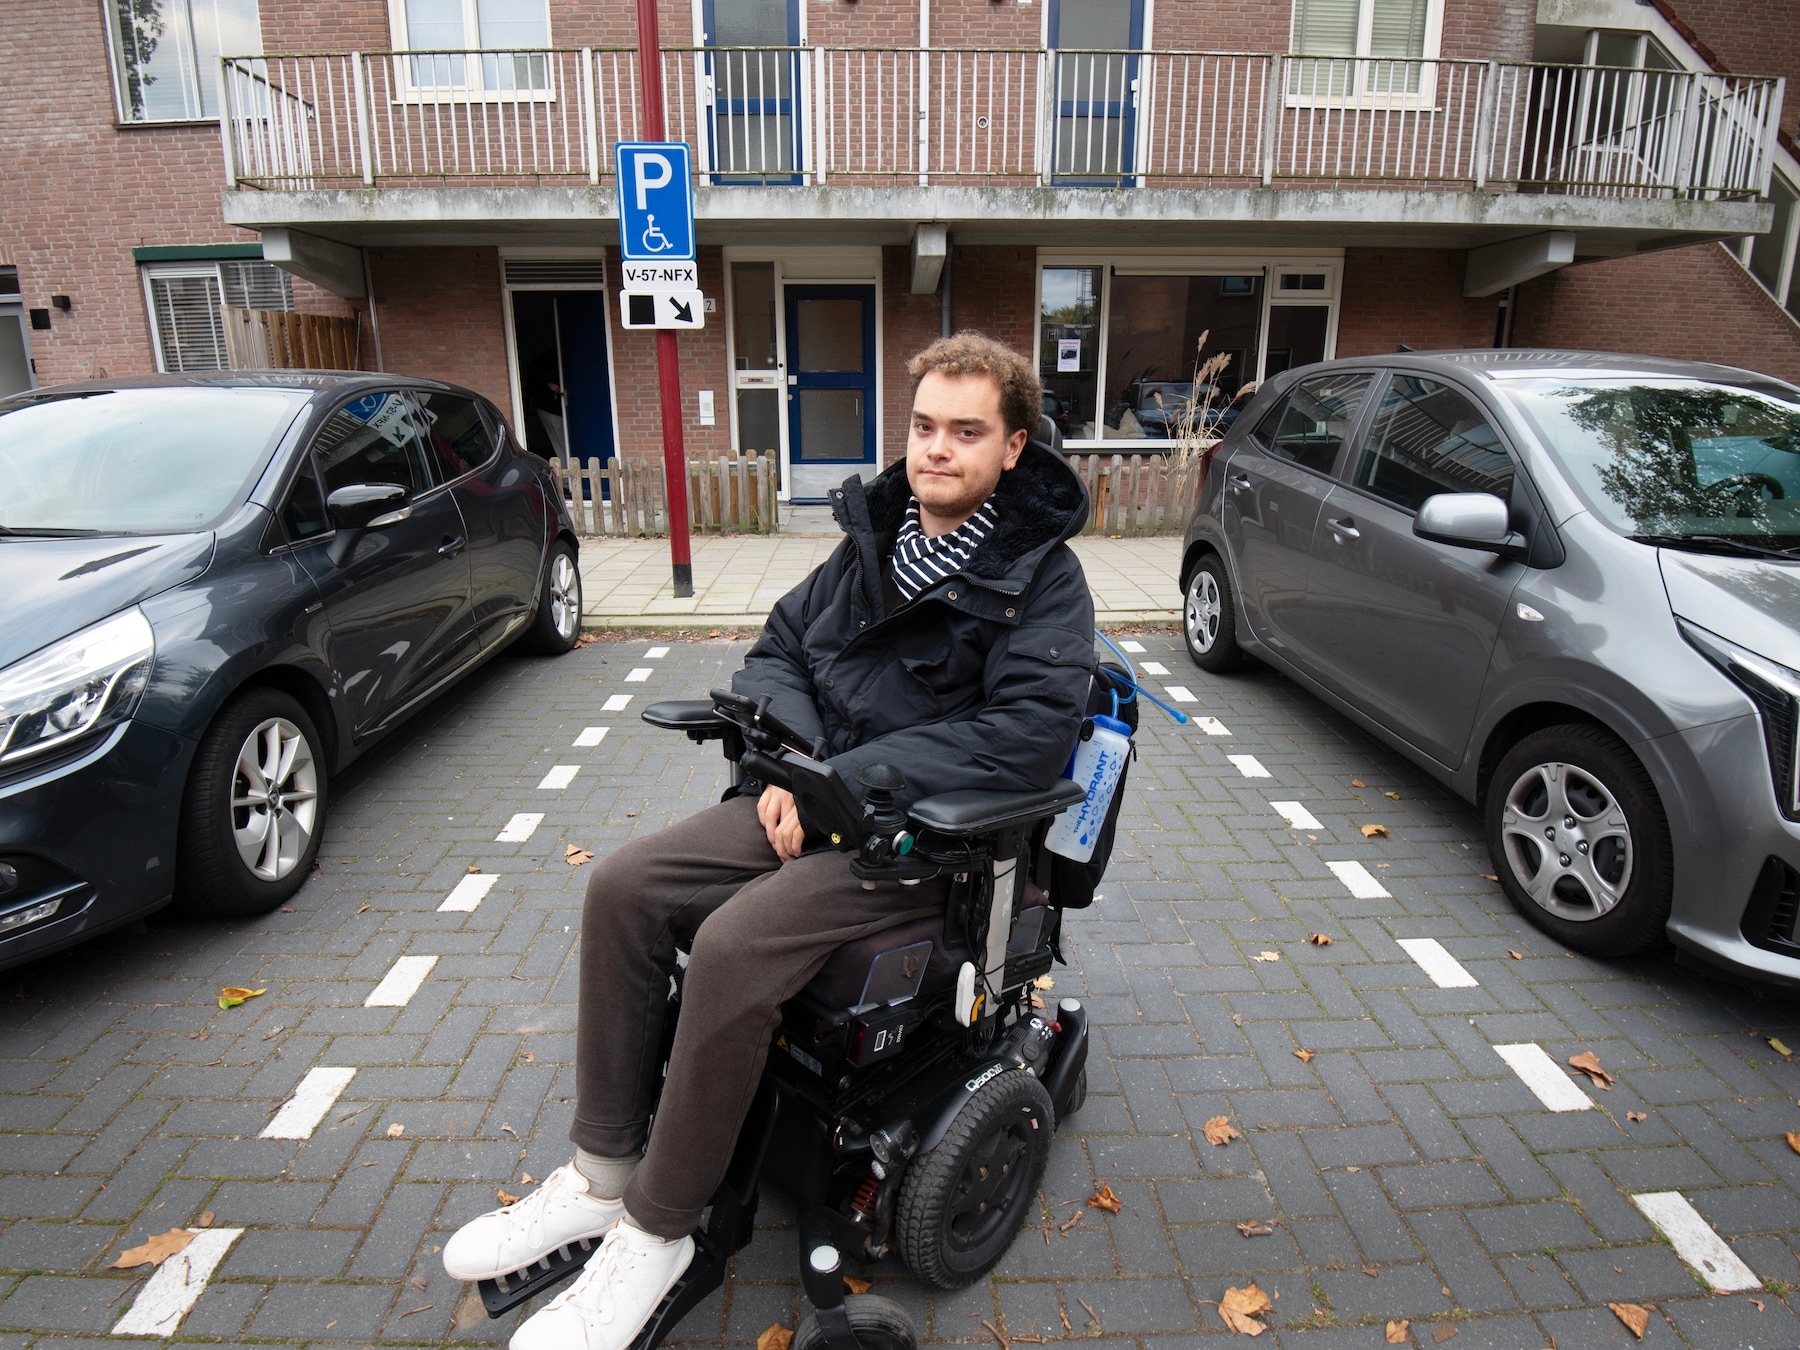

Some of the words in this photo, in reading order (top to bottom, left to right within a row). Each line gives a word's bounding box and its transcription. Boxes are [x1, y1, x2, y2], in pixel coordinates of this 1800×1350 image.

[634, 153, 672, 210] P
[626, 269, 694, 281] V-57-NFX
[706, 300, 712, 311] 2
[1073, 819, 1082, 834] THE
[1079, 750, 1109, 821] HYDRANT
